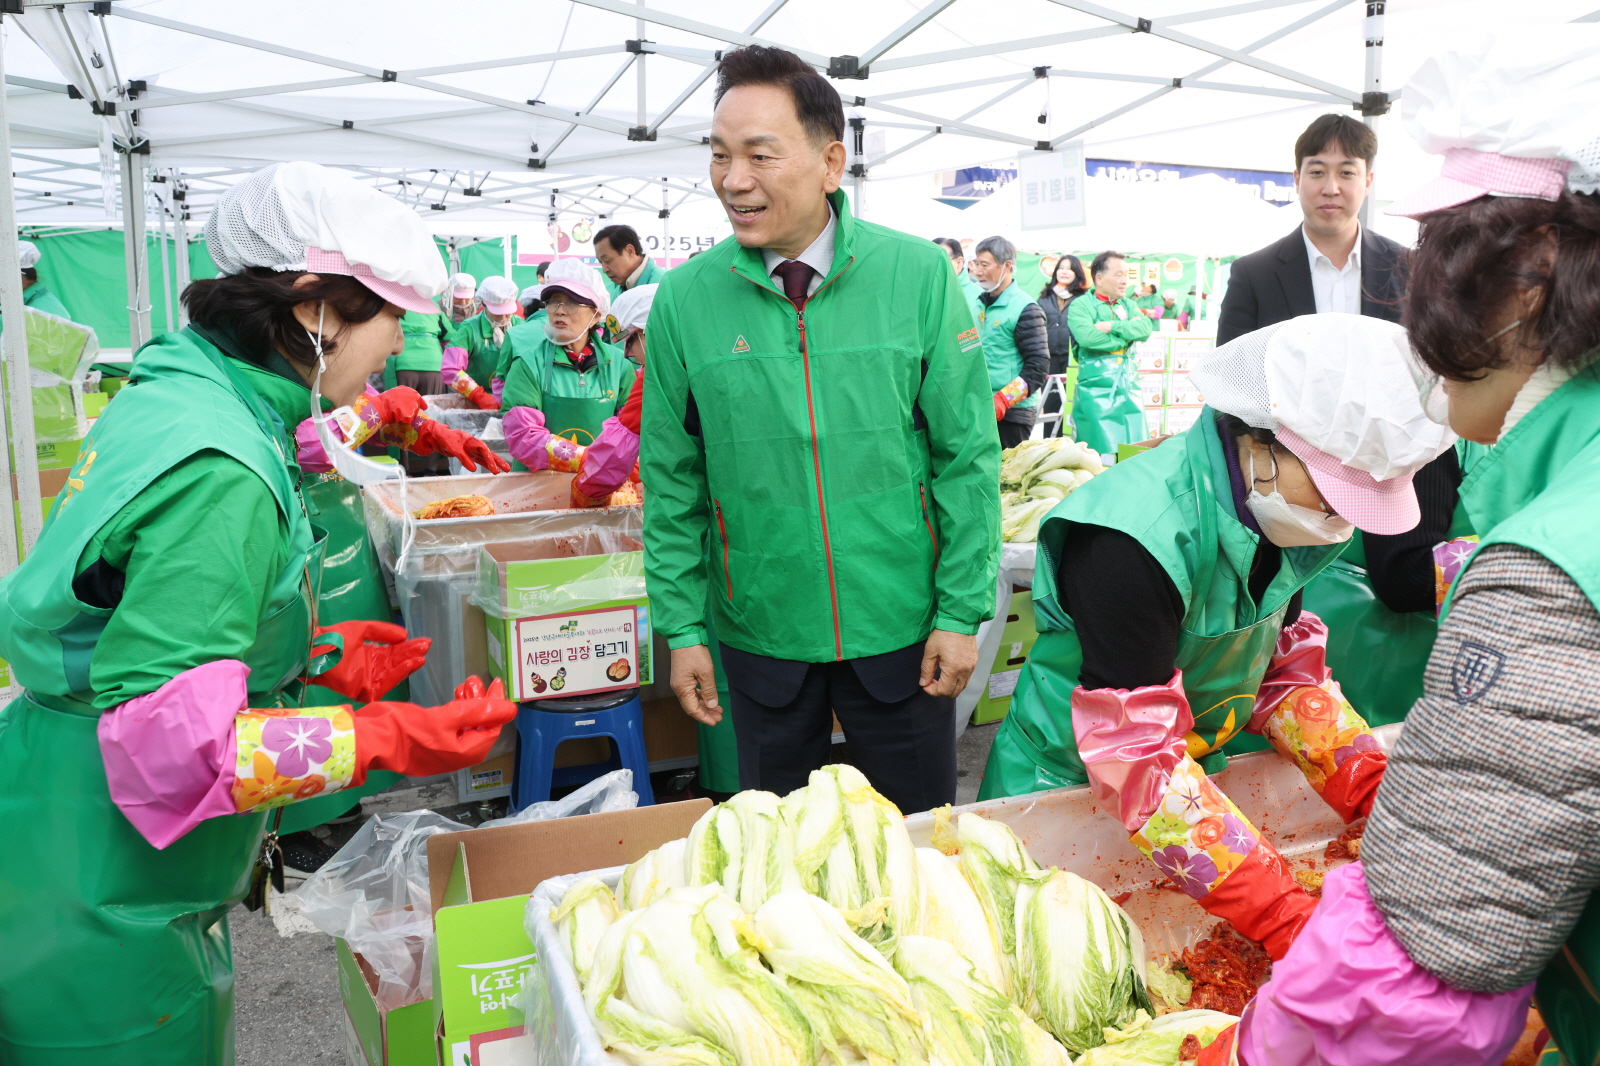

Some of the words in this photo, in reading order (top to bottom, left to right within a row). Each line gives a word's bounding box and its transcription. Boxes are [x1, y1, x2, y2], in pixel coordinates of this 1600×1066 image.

[526, 648, 563, 666] 사랑의
[566, 645, 591, 662] 김장
[594, 640, 629, 658] 담그기
